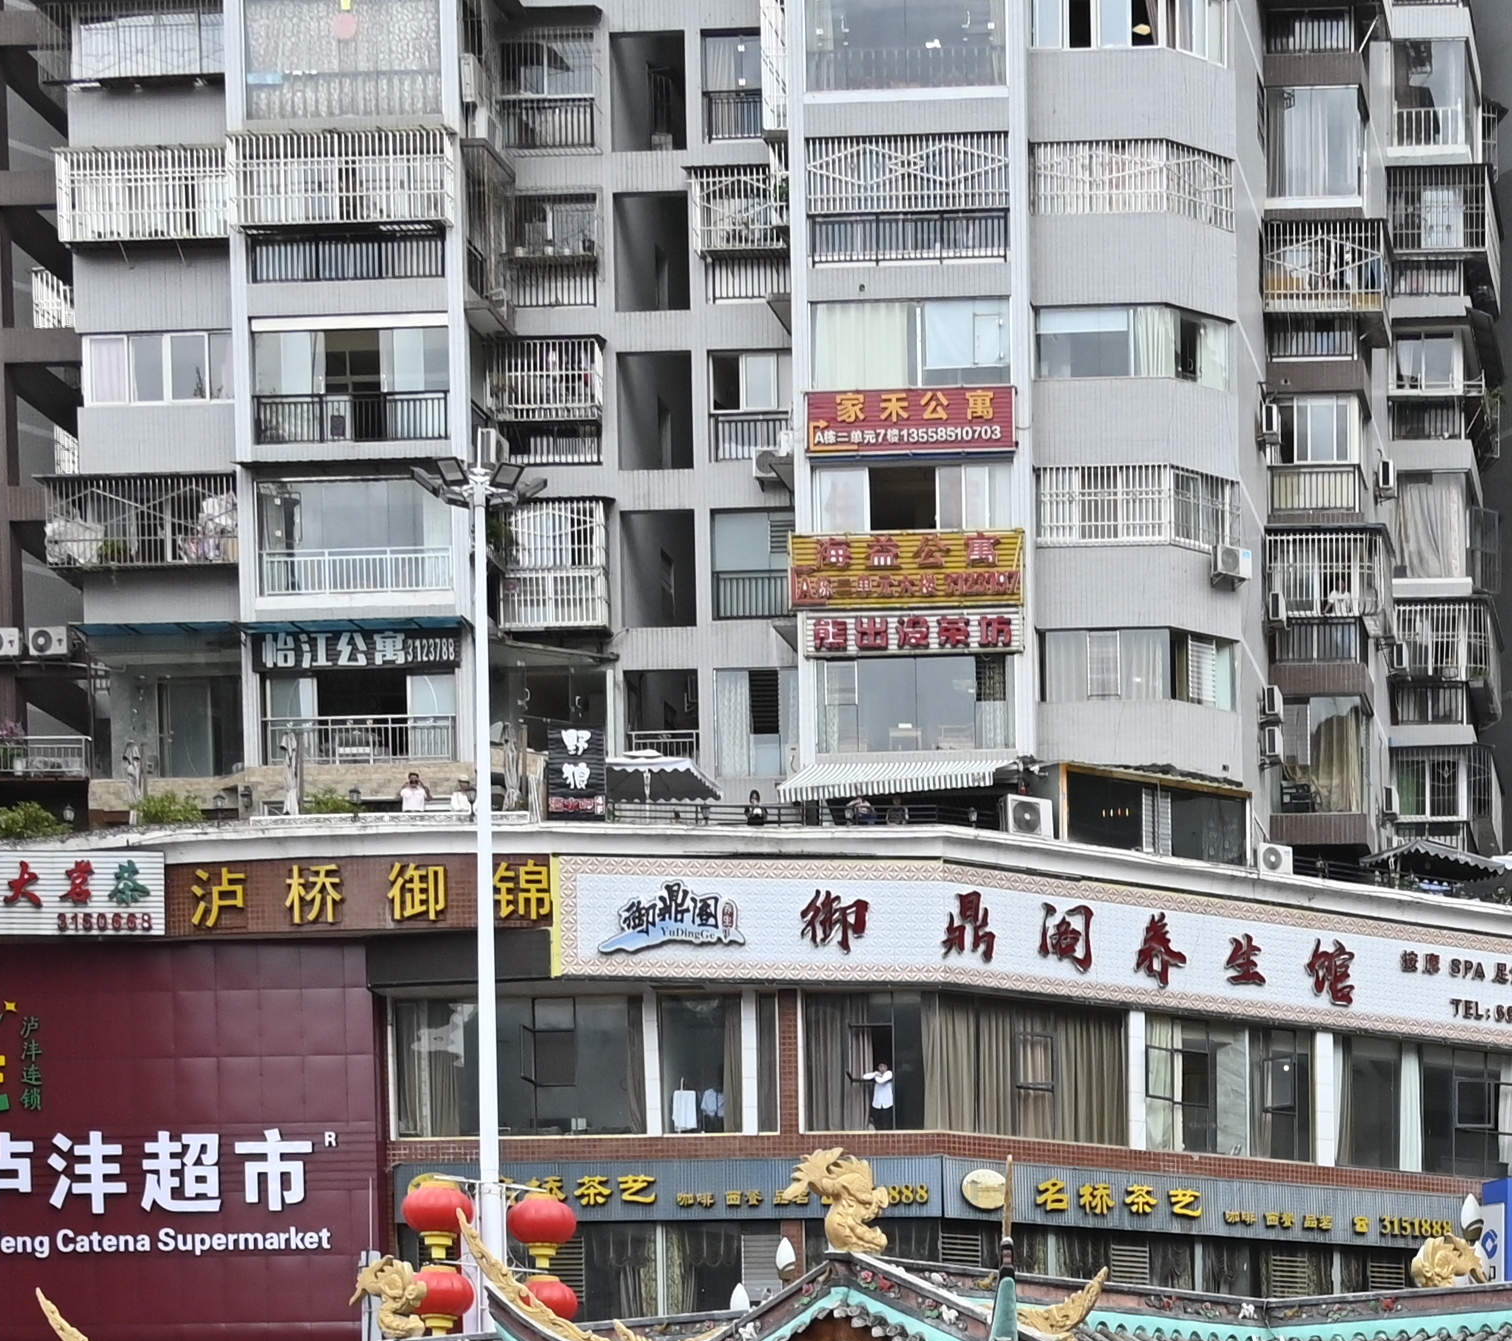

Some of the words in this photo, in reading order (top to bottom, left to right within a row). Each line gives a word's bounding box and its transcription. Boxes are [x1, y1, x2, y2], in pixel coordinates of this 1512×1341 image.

[836, 389, 994, 423] 家禾公寓
[262, 632, 406, 668] 怡江公寓
[406, 638, 456, 662] 3123788
[813, 616, 1012, 650] 熊出没茶坊
[191, 859, 552, 928] 泸桥御锦
[800, 888, 1356, 1006] 御鼎阁养生馆
[1449, 958, 1486, 980] SPA
[1036, 1177, 1203, 1217] 名桥茶艺
[56, 1228, 151, 1254] Catena
[157, 1225, 332, 1256] Supermarket
